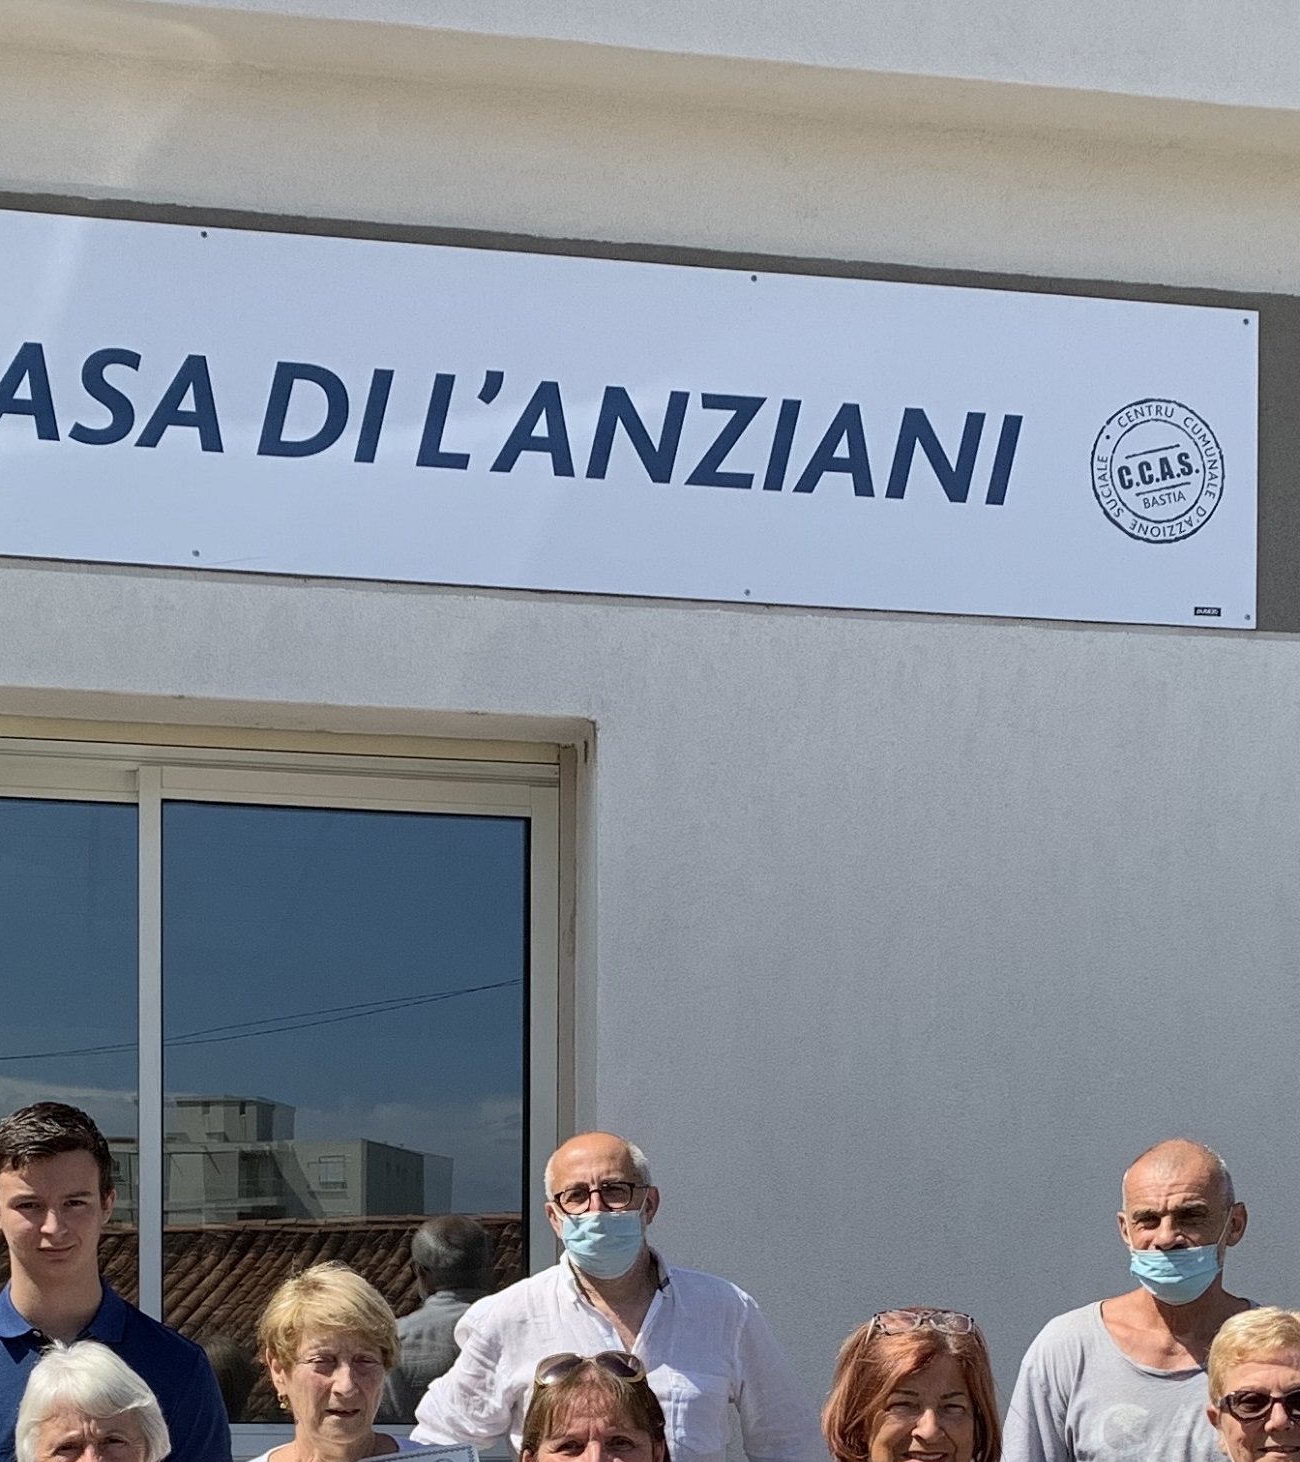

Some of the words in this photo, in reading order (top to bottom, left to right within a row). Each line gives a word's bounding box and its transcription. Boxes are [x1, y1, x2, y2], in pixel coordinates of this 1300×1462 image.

[256, 361, 396, 464] DI
[414, 370, 1024, 506] L'ANZIANI
[1116, 404, 1175, 429] CENTRU
[1117, 452, 1200, 491] C.C.A.S.
[1182, 416, 1219, 500] CUMUNALE
[1096, 455, 1125, 519] SUCIALE
[1142, 490, 1187, 510] BASTIA
[1128, 504, 1208, 538] D'AZZIONE
